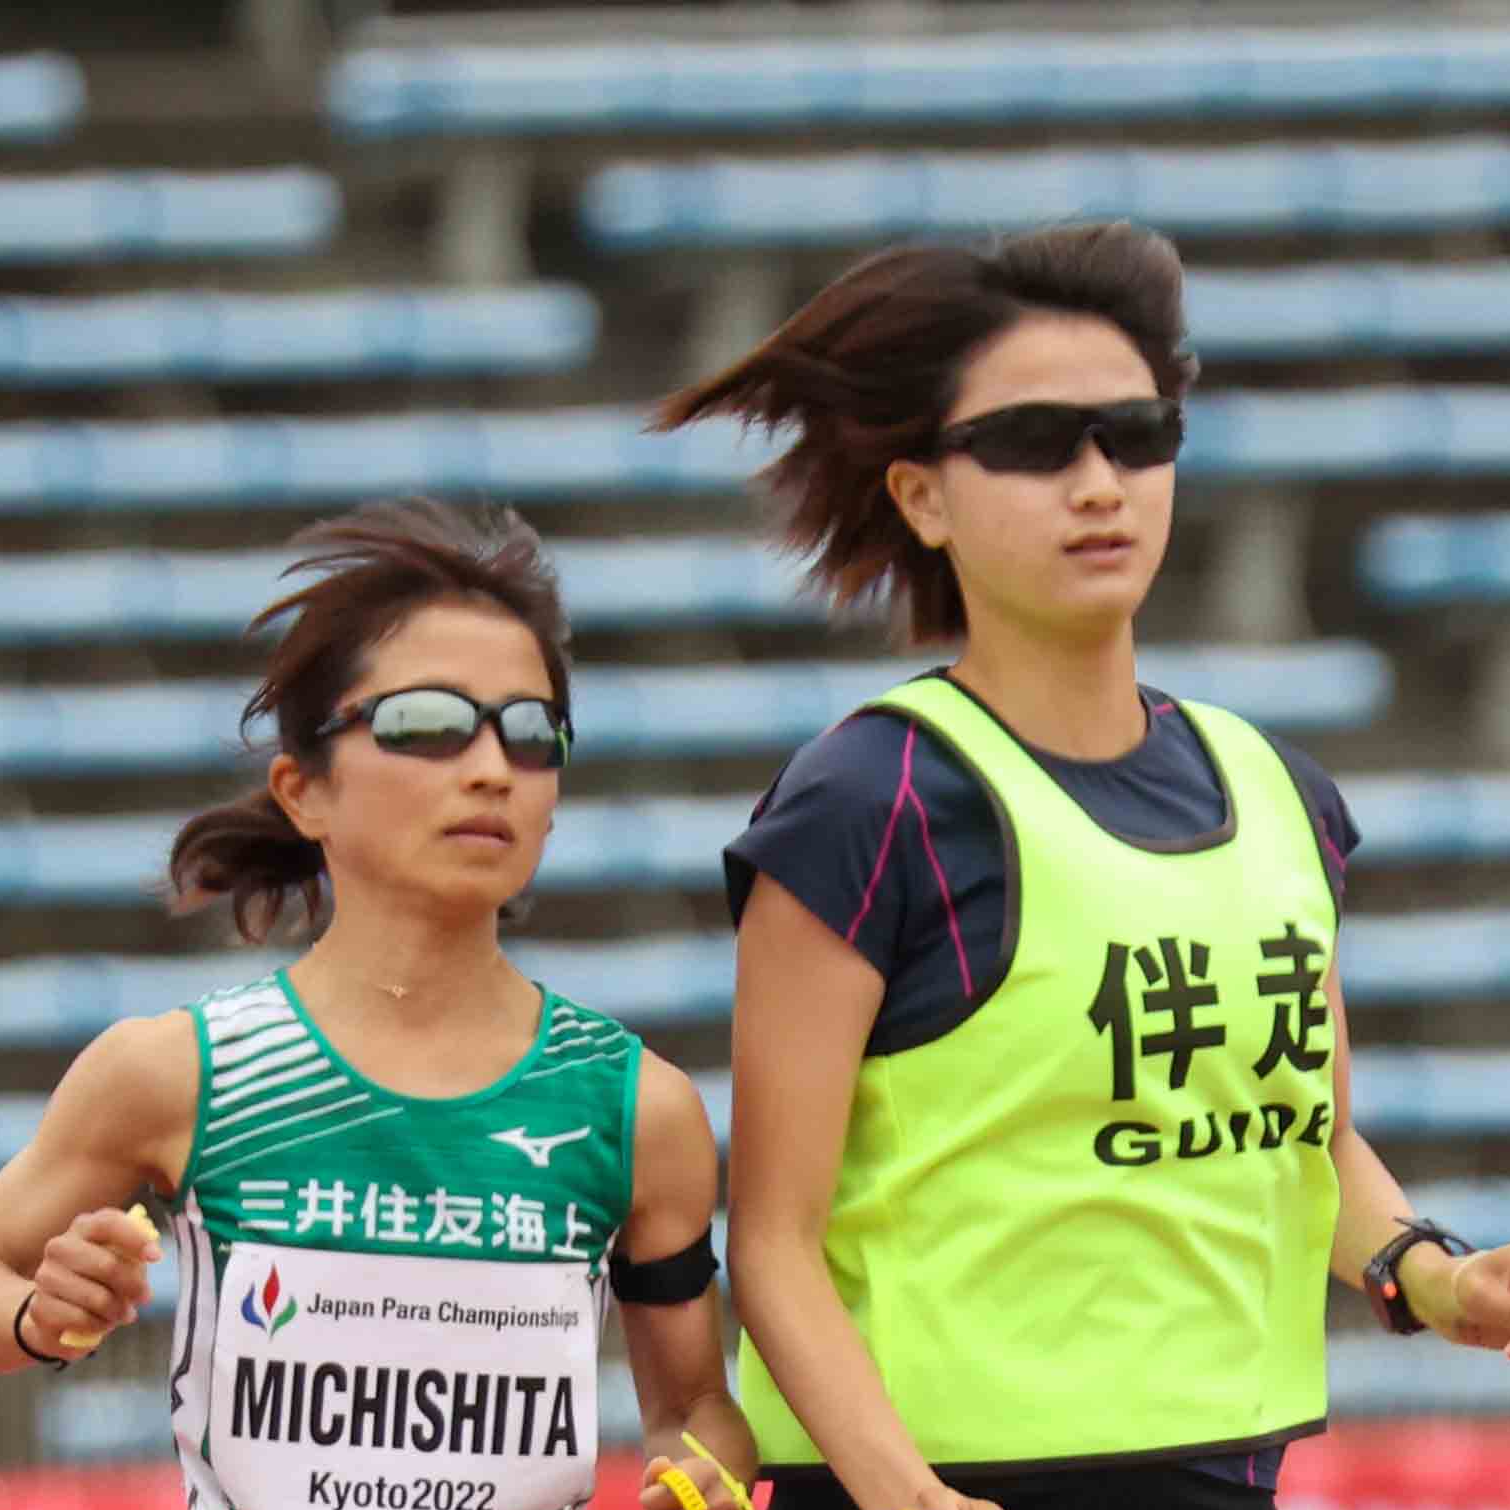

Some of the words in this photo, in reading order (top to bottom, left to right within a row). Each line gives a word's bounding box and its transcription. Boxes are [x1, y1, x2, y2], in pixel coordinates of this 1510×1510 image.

[1087, 922, 1329, 1101] 伴走
[1093, 1102, 1329, 1167] GUIDE
[238, 1178, 592, 1260] 三井住友海上
[307, 1293, 376, 1319] Japan
[381, 1298, 431, 1321] Para
[438, 1301, 579, 1333] Championships
[231, 1356, 579, 1457] MICHISHITA
